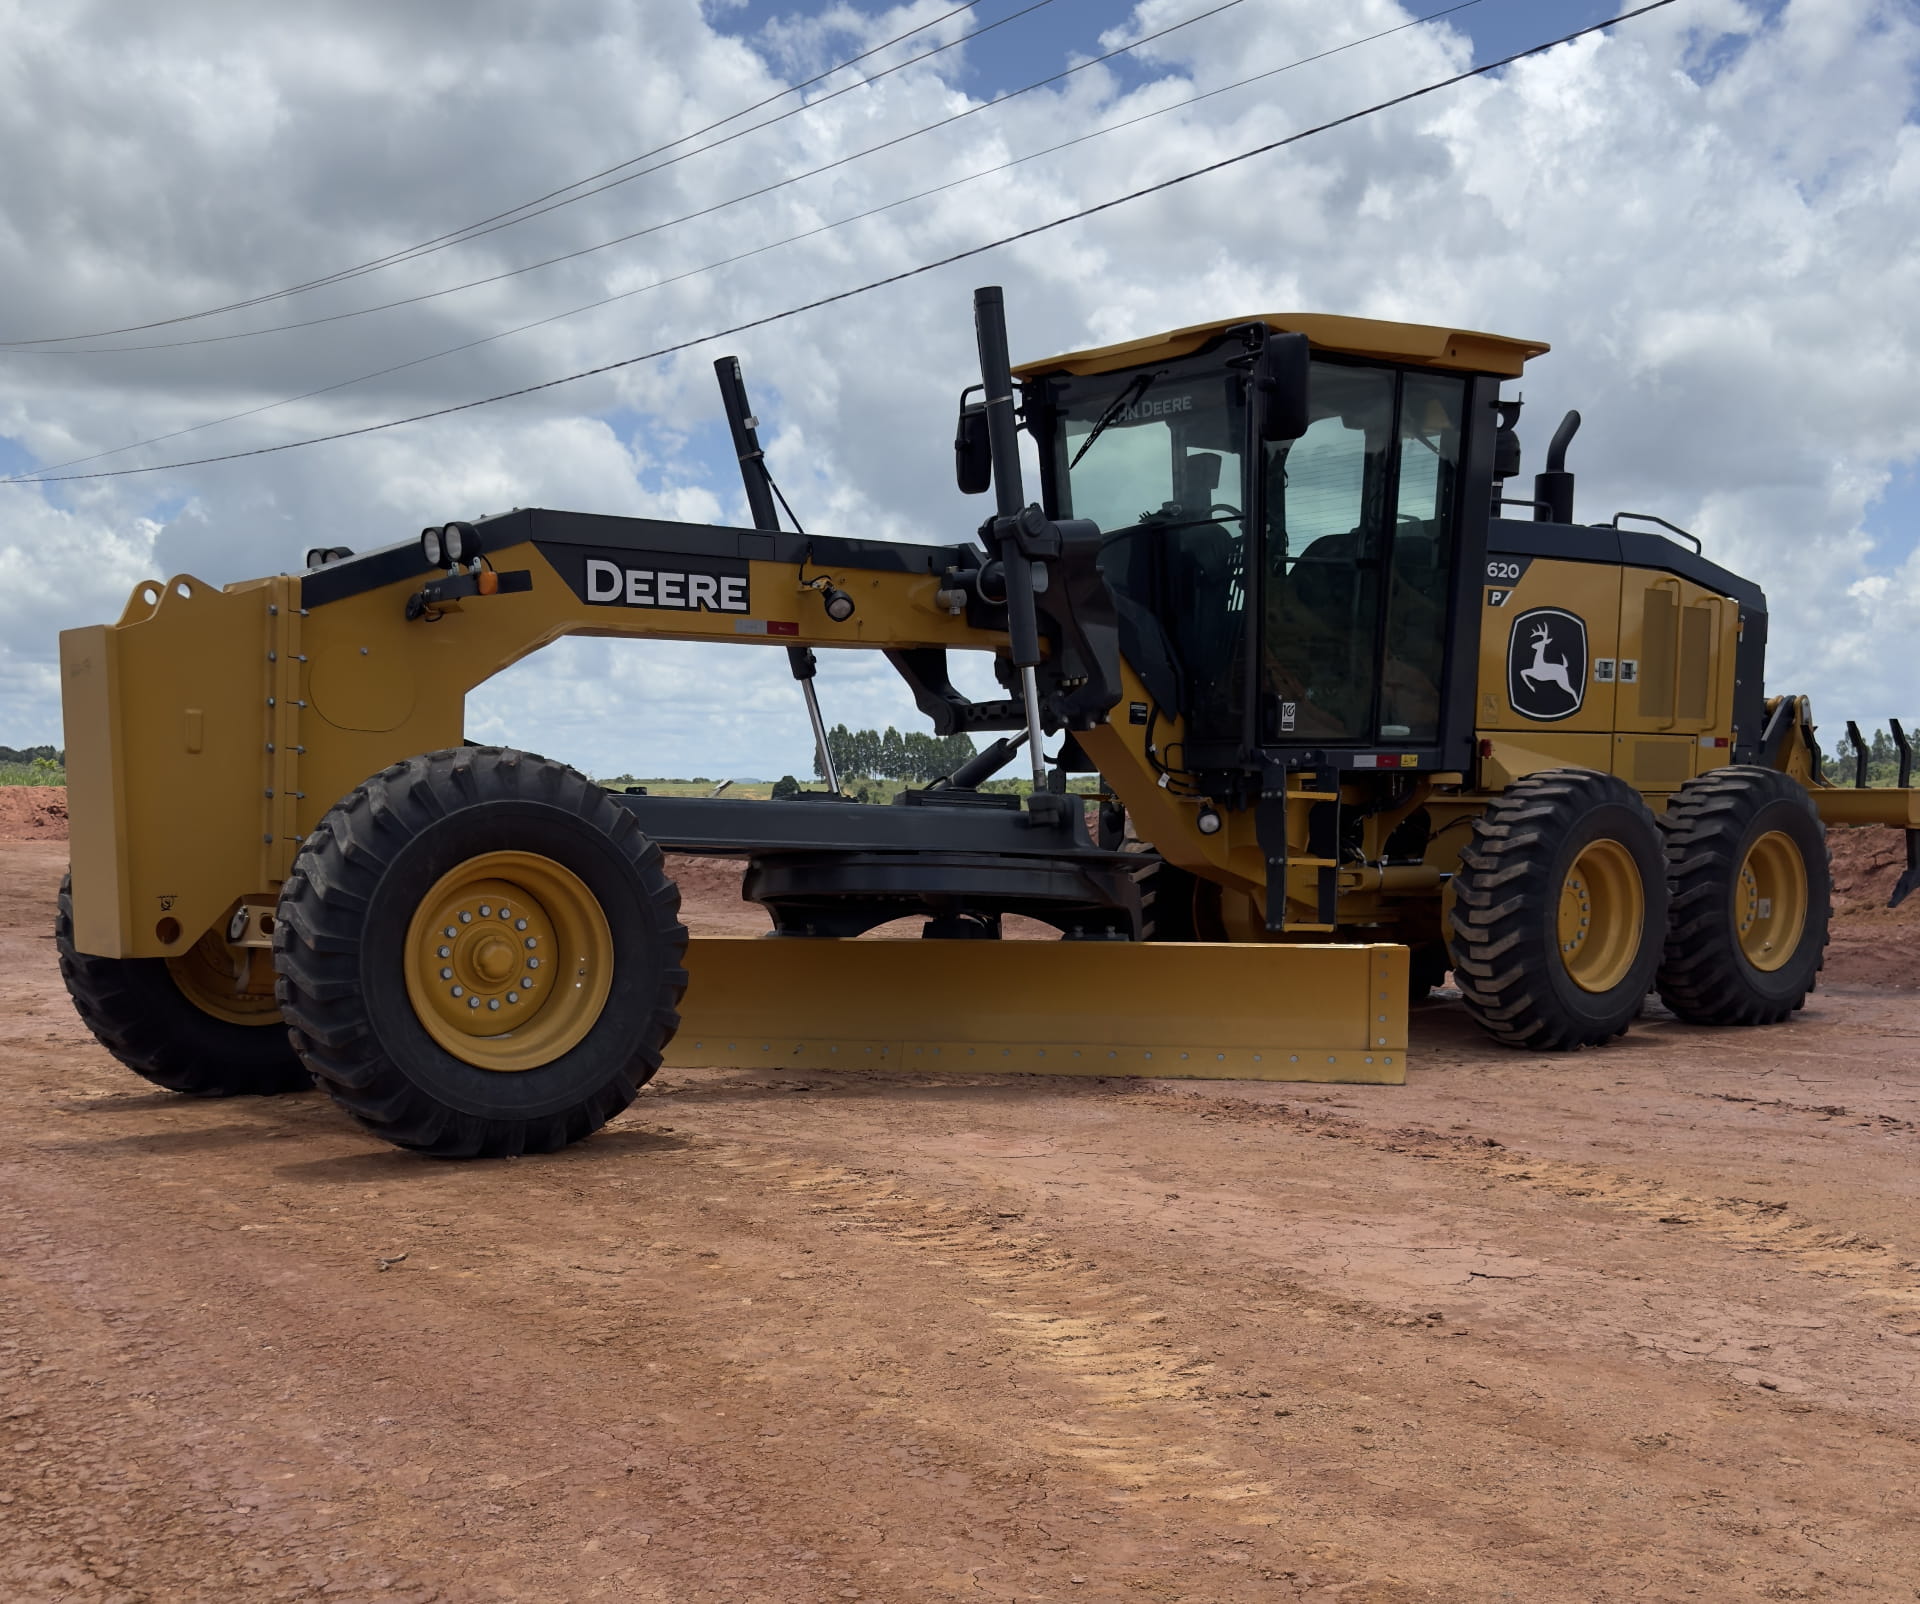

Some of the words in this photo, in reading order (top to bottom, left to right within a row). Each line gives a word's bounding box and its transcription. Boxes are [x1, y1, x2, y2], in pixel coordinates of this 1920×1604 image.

[1141, 396, 1193, 417] DEERE
[1487, 562, 1520, 579] 620
[586, 559, 748, 611] DEERE
